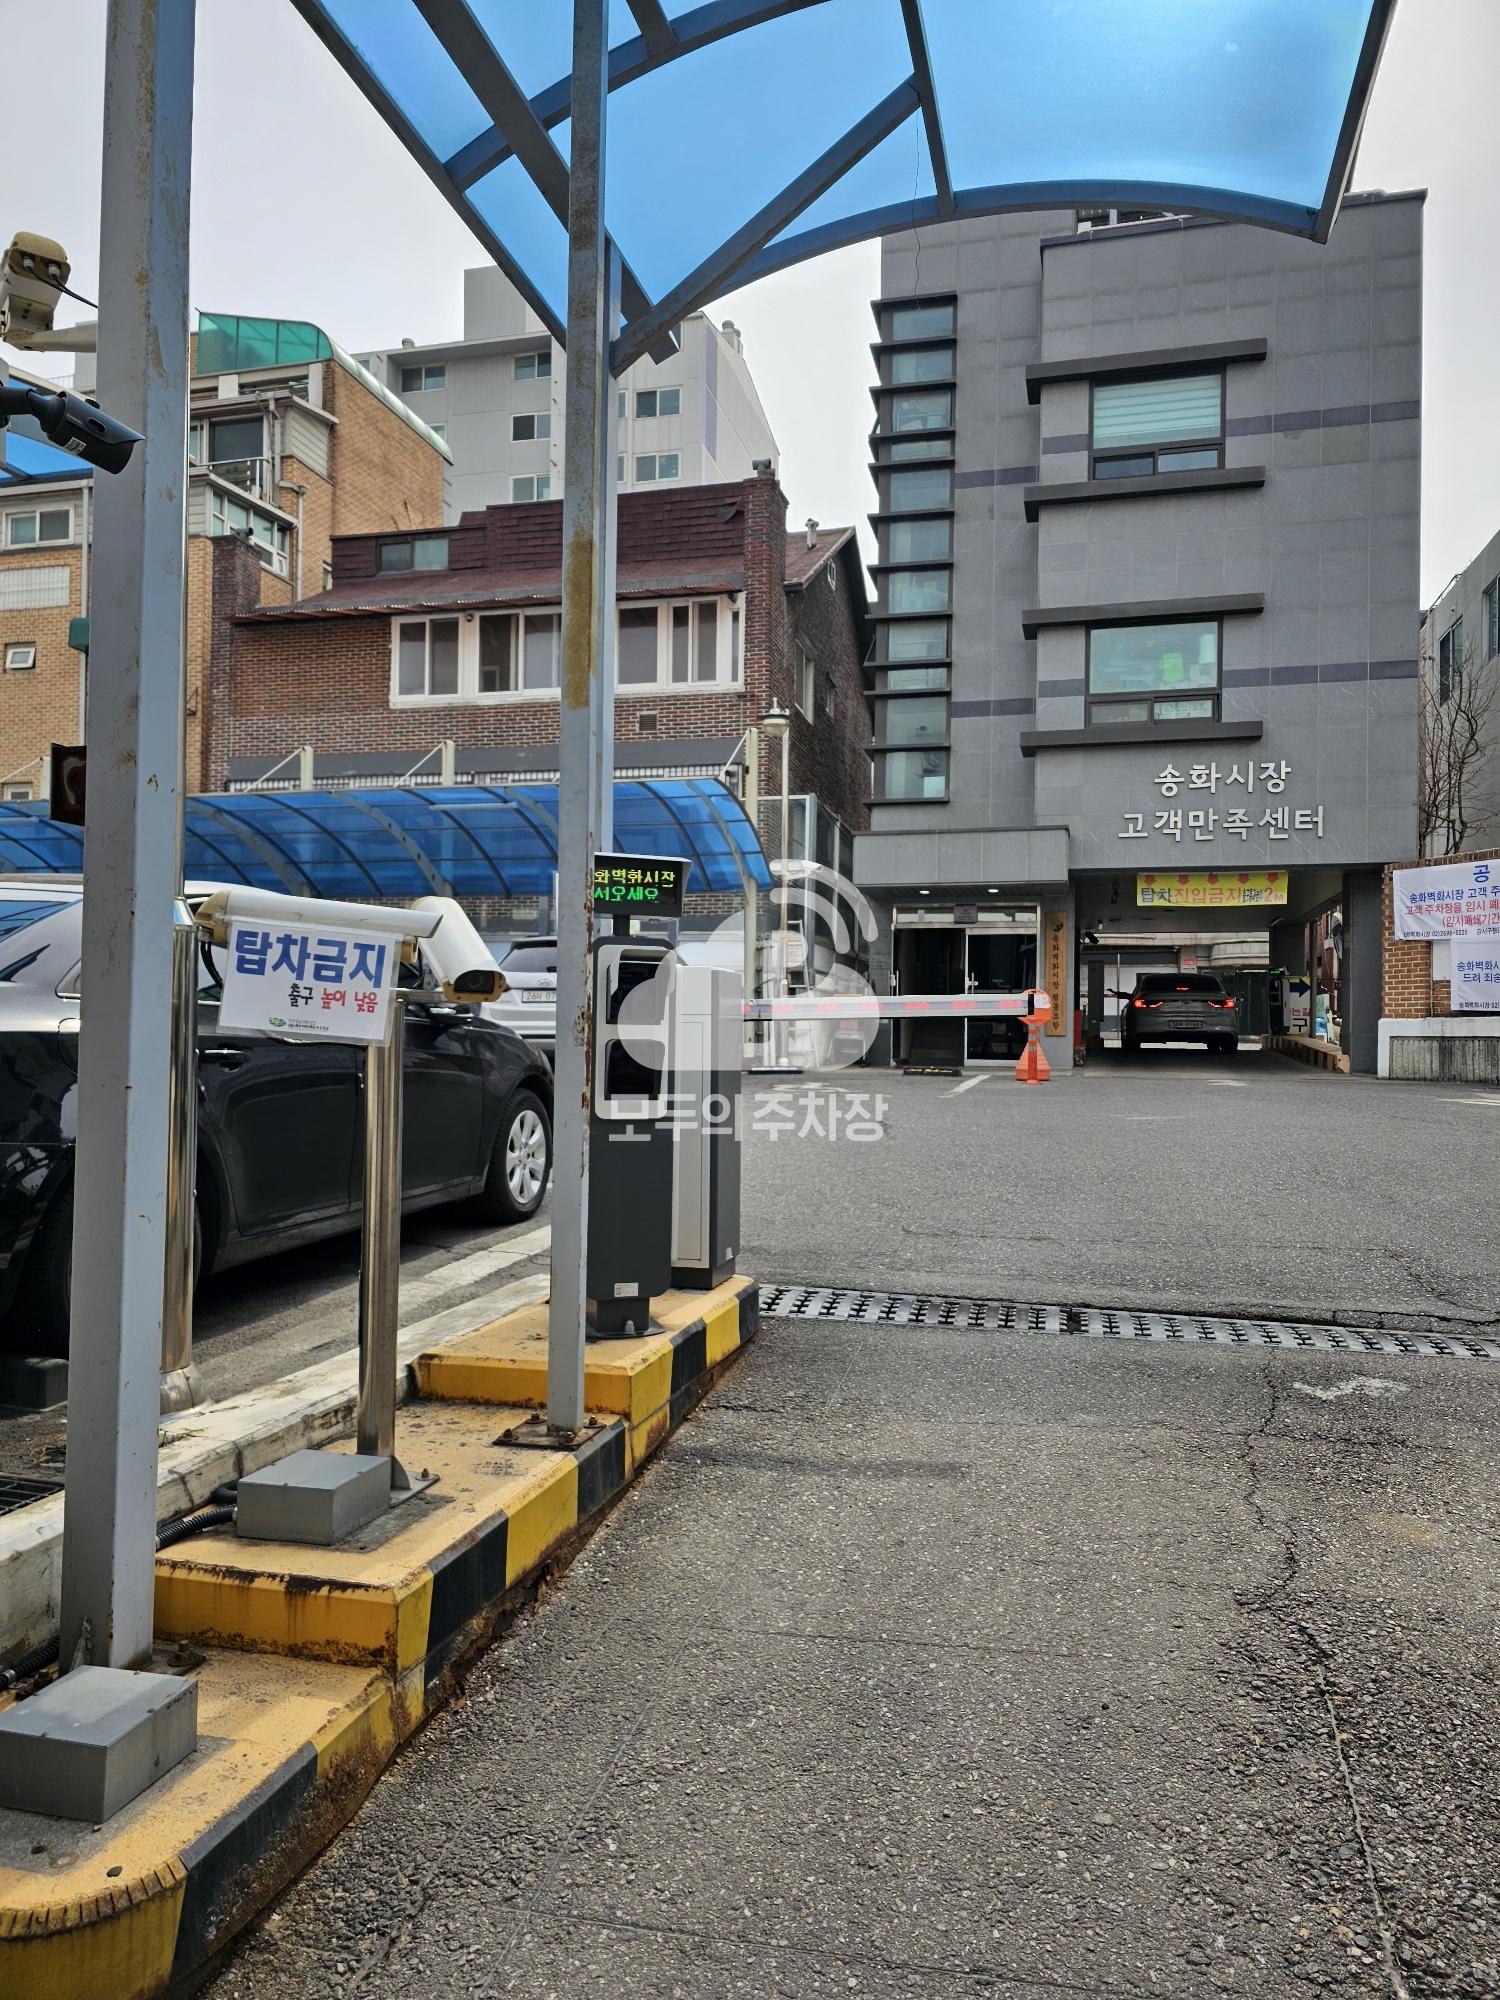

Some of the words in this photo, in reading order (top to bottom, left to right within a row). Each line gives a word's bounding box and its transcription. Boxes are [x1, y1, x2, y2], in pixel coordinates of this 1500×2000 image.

[1154, 760, 1292, 797] 송화시장
[1118, 805, 1324, 842] 고객만족센터
[1473, 864, 1490, 883] 공
[1409, 889, 1464, 904] 송화벽화시장
[1467, 887, 1487, 899] 고객
[1425, 902, 1462, 915] 주차장을
[1466, 900, 1486, 912] 임시
[236, 930, 386, 988] 탑차금지
[1463, 973, 1481, 983] 드려
[288, 983, 313, 1007] 출구
[321, 988, 346, 1009] 높이
[354, 991, 378, 1013] 낮음
